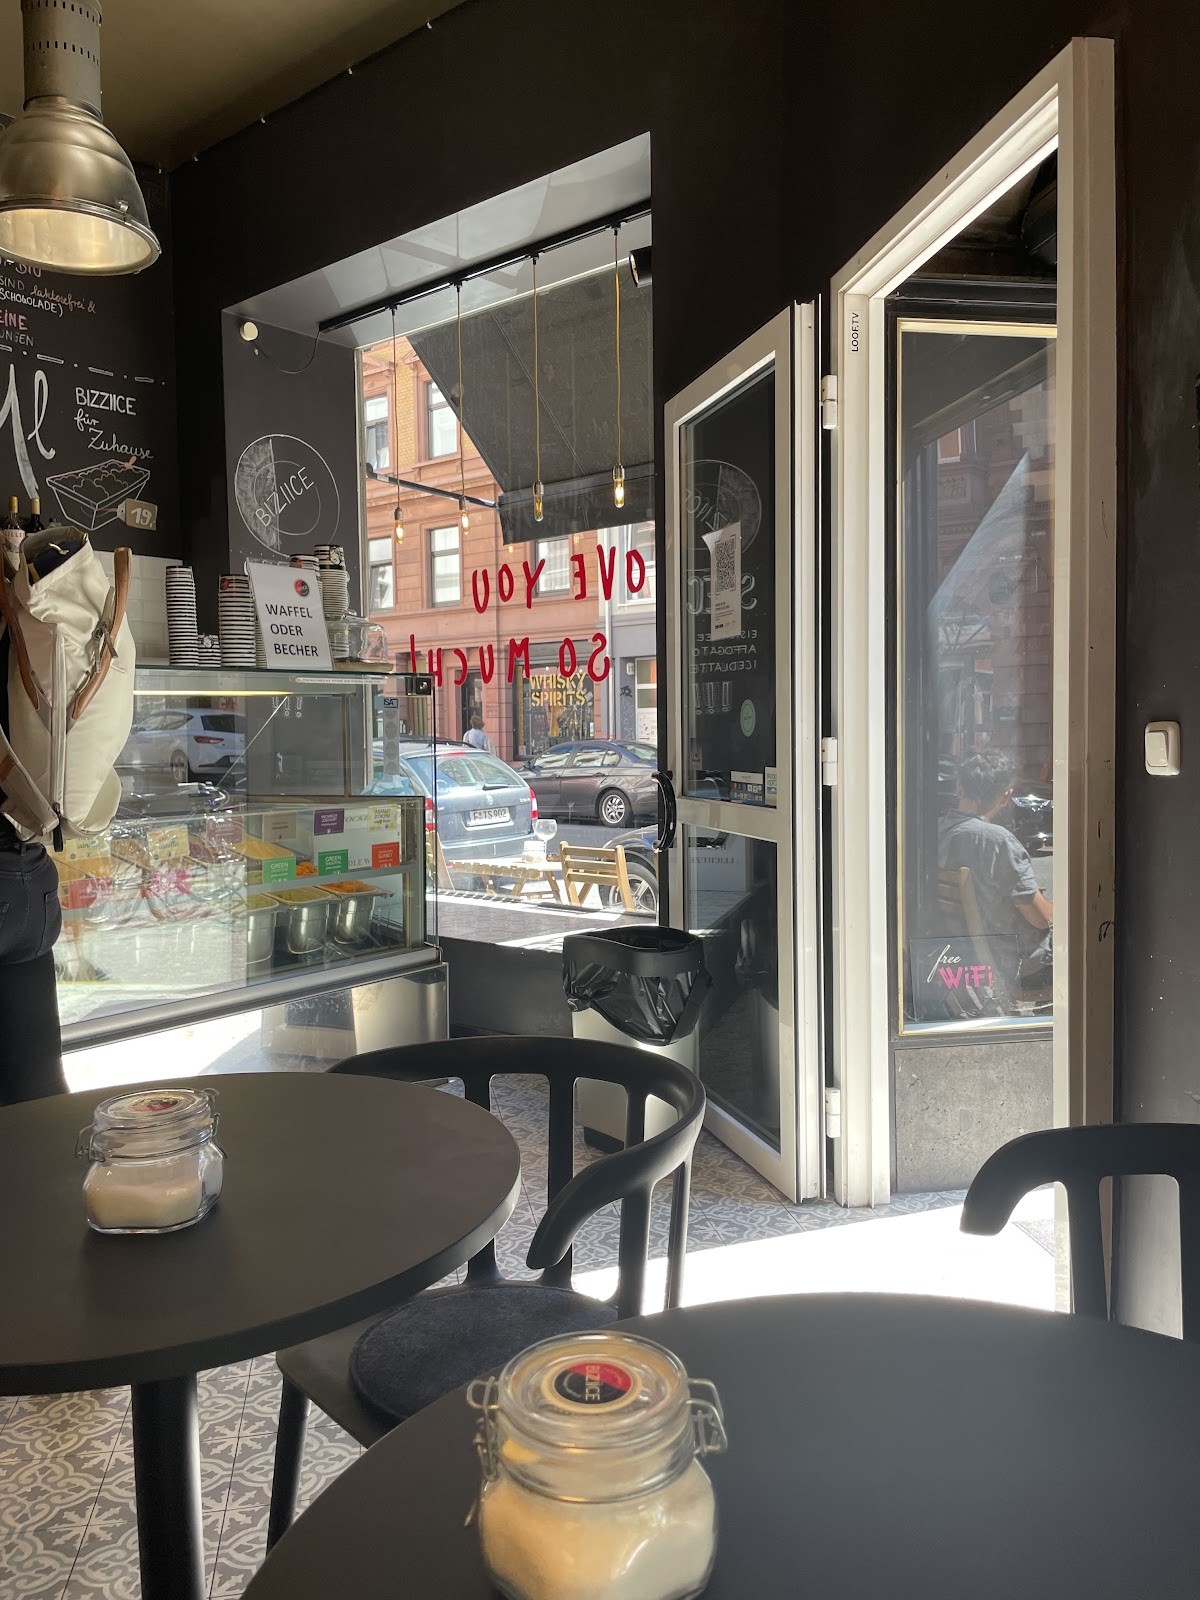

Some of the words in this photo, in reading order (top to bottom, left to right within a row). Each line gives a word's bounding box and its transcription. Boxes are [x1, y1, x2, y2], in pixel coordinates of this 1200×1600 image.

[851, 312, 859, 352] LOOF.TV
[75, 387, 137, 416] BIZZIICE
[74, 408, 100, 432] für
[87, 427, 154, 459] Zuhause
[265, 603, 313, 619] WAFFEL
[270, 623, 304, 637] ODER
[273, 643, 319, 657] BECHER
[529, 672, 586, 690] WHISKY
[531, 690, 586, 707] SPIRITS
[926, 944, 962, 983] free
